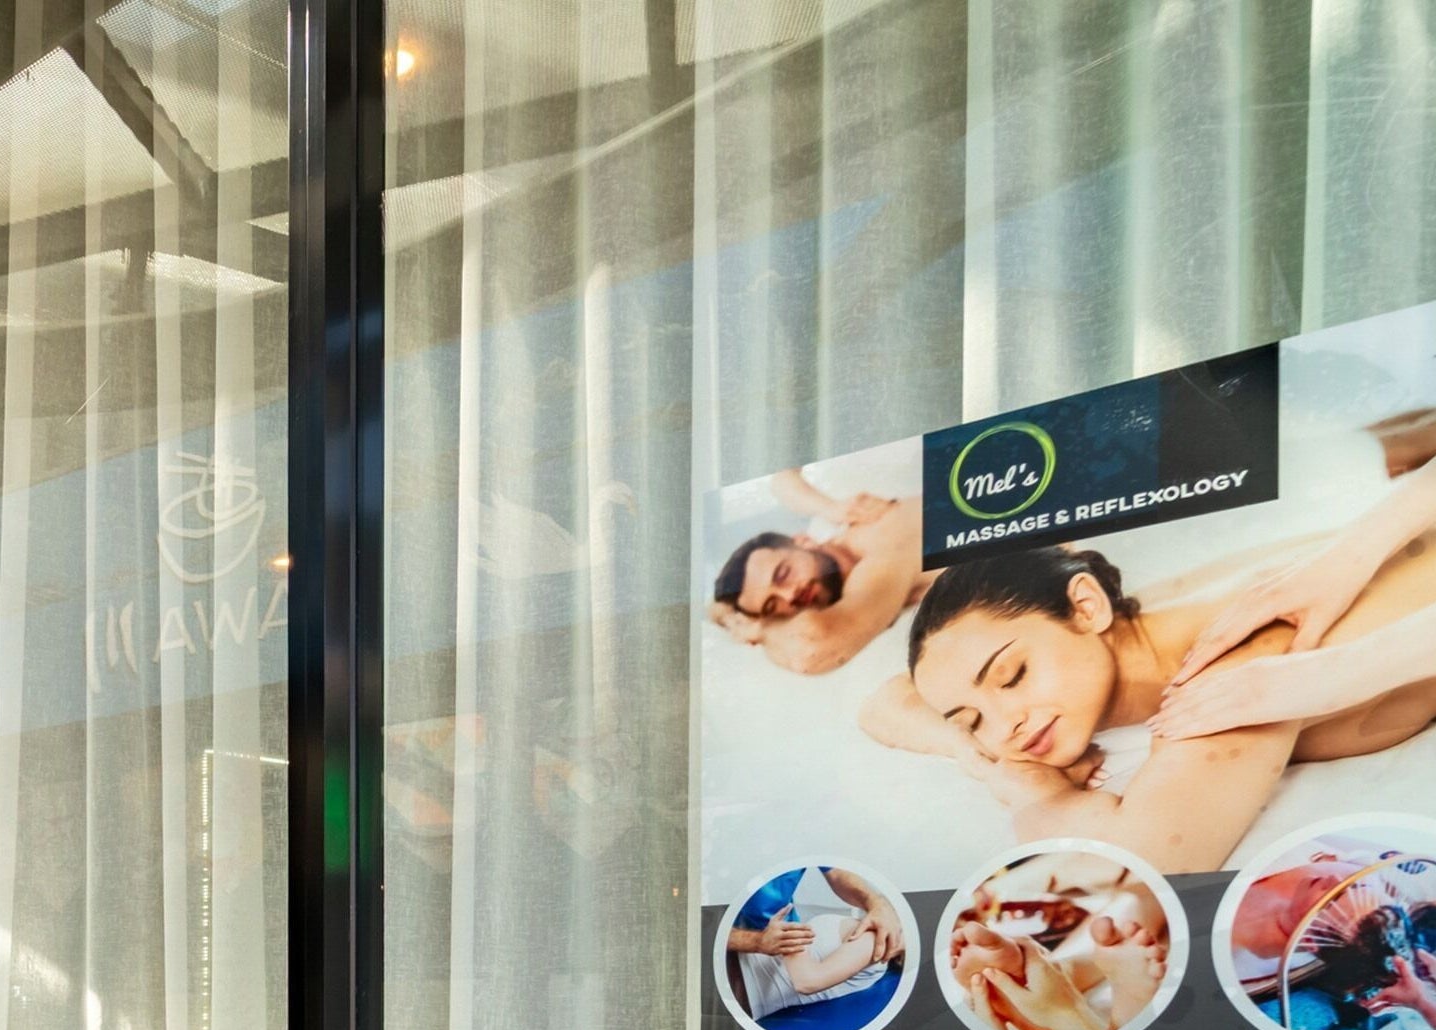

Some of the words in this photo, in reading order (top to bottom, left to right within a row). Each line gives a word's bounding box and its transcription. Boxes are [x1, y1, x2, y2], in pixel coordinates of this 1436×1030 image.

[946, 513, 1050, 548] MASSAGE
[1055, 509, 1070, 525] &
[1076, 470, 1249, 521] REFLEXOLOGY
[964, 463, 1039, 499] Mel's
